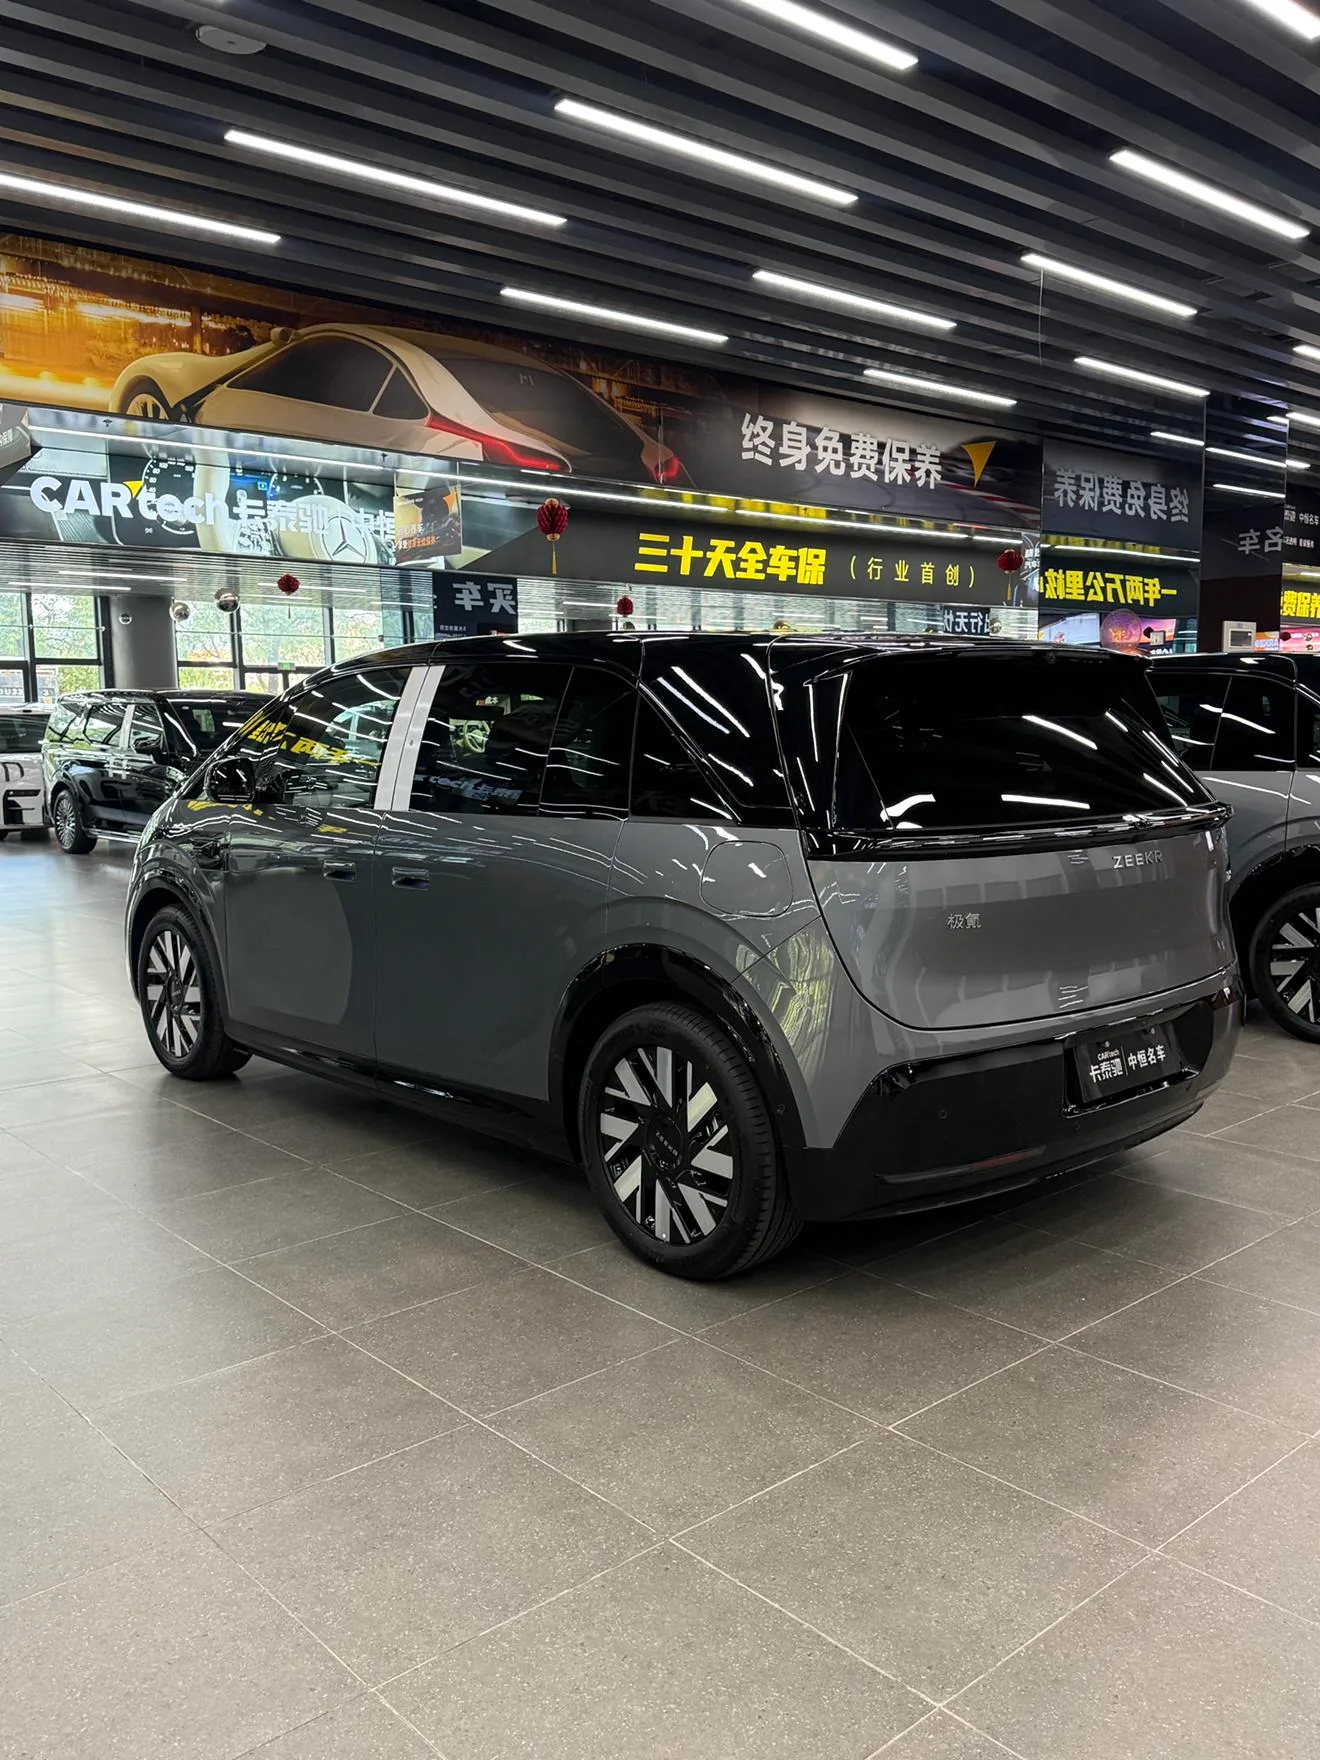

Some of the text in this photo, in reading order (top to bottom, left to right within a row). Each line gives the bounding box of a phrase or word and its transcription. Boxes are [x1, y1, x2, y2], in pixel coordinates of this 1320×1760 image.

[741, 413, 943, 490] 终身免费保养
[634, 533, 827, 585] 三十天全车保
[1112, 849, 1163, 869] ZEEKR
[947, 912, 982, 929] 极氪
[1089, 1044, 1166, 1083] 卡泰驰 中恒名车
